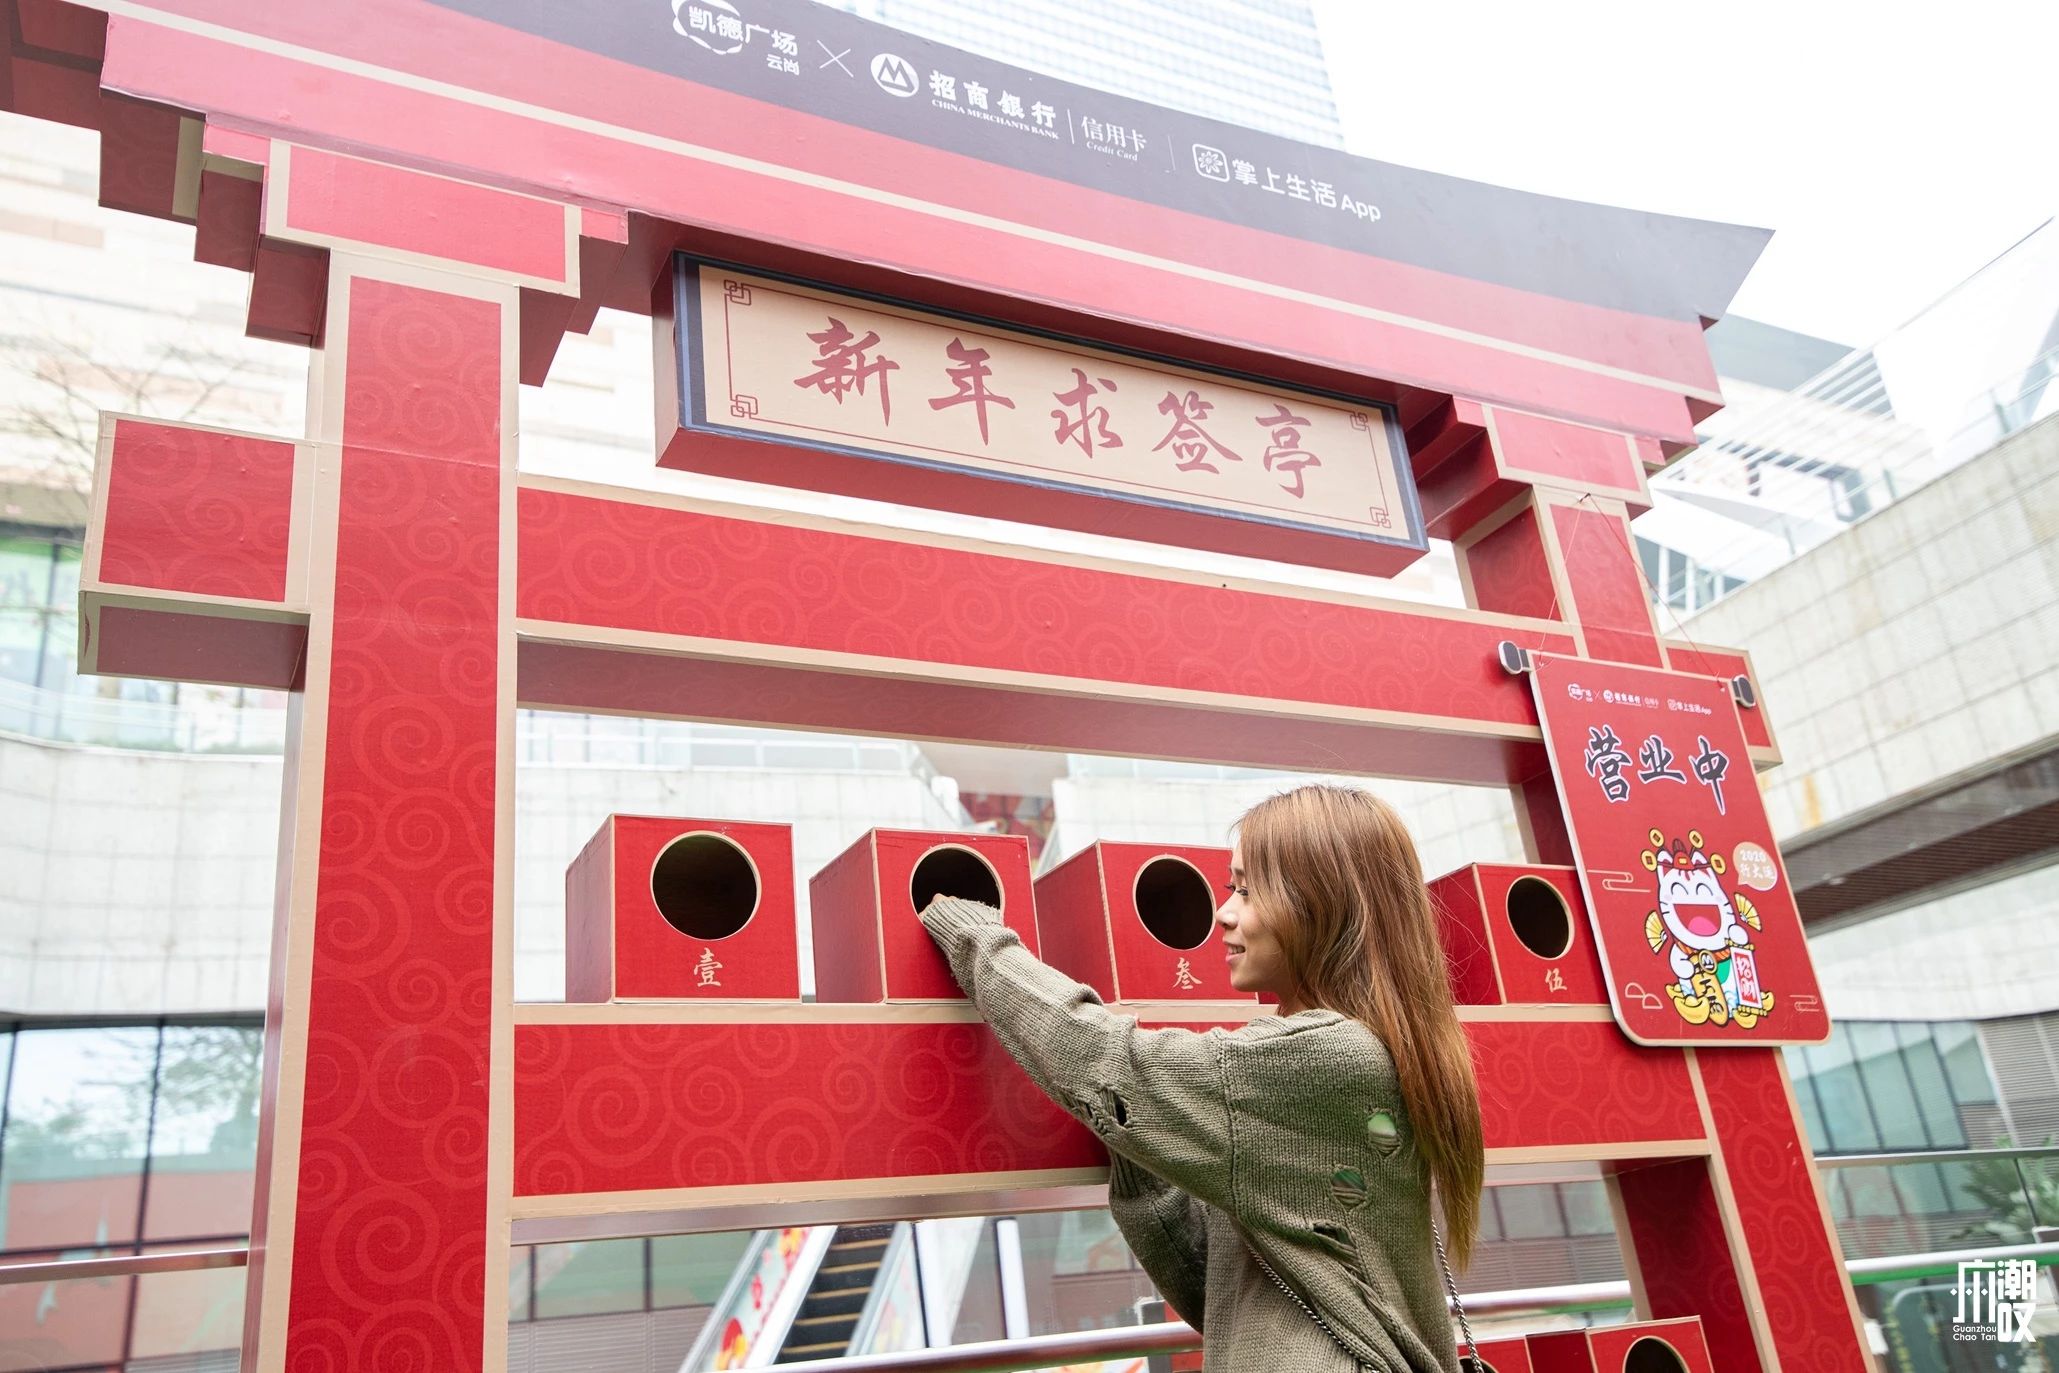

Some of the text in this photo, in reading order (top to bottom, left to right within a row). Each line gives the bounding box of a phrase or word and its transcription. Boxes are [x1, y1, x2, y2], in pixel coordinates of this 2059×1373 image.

[688, 5, 798, 56] 凯德广场
[766, 53, 800, 76] 云尚
[931, 98, 1060, 140] CHINA MERCHANTS BANK
[1080, 115, 1148, 152] 信用卡
[1085, 139, 1139, 161] Credit Card
[793, 316, 1323, 499] 新年求签亭
[1583, 723, 1730, 816] 营业中
[1740, 849, 1767, 863] 2020
[693, 946, 723, 988] 壹
[1544, 967, 1568, 993] 伍
